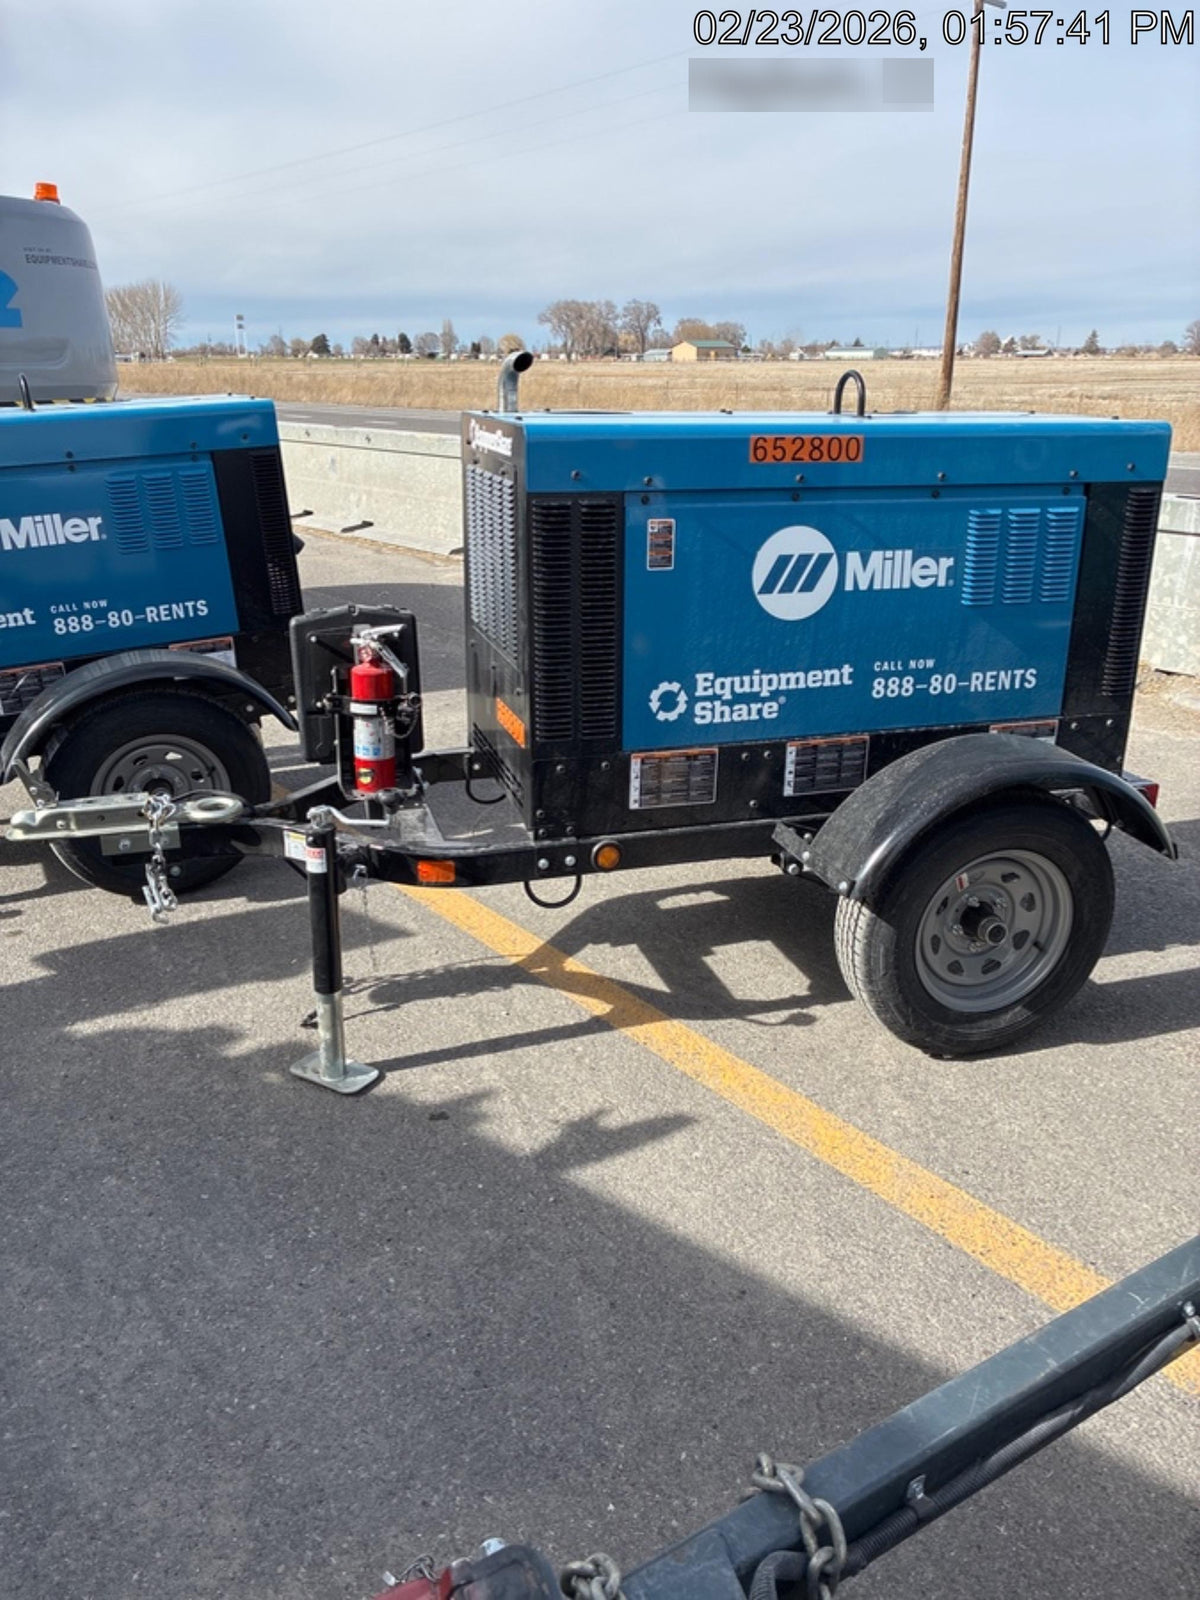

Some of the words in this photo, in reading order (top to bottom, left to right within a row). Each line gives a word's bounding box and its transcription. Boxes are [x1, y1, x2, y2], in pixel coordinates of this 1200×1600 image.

[753, 436, 861, 462] 652800
[51, 604, 78, 614] CALL
[84, 600, 108, 609] NOW
[53, 600, 209, 635] 888-80-RENTS
[873, 661, 903, 671] CALL
[909, 658, 936, 669] NOW
[695, 664, 854, 699] Equipment
[871, 668, 1037, 699] 888-80-RENTS
